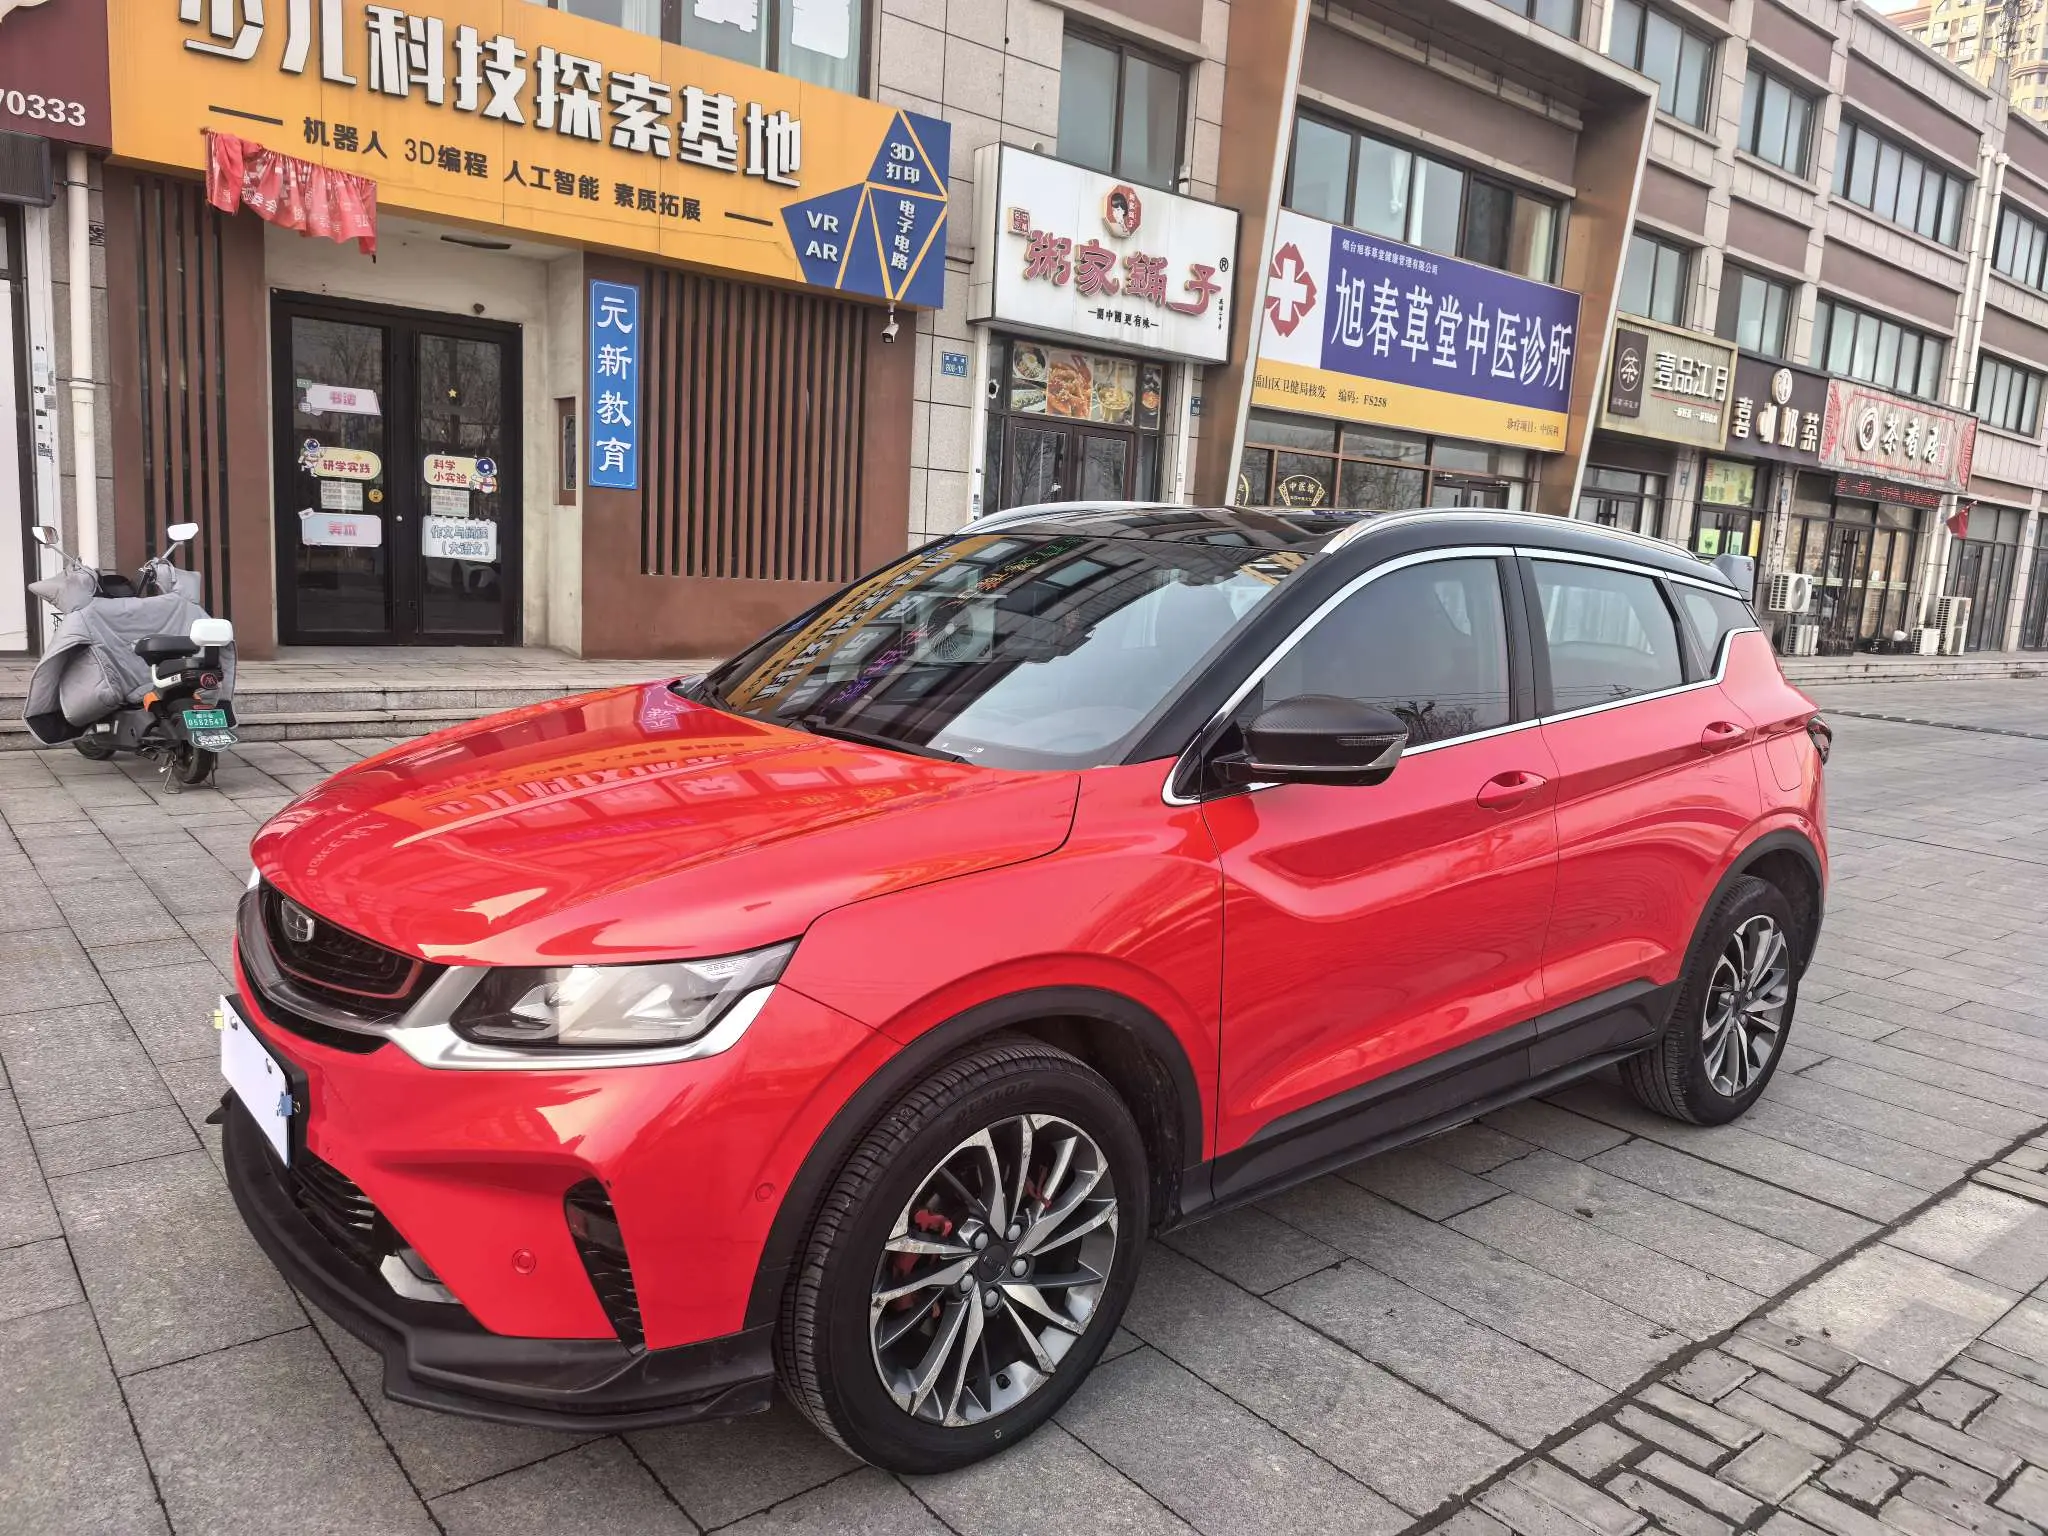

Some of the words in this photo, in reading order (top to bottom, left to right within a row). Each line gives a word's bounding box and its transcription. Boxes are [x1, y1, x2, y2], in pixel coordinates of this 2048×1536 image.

[178, 0, 801, 188] 少儿科技探索基地
[889, 141, 916, 163] 3D
[303, 116, 388, 159] 机器人
[404, 138, 489, 179] 3D编程
[503, 160, 600, 202] 人工智能
[613, 182, 702, 224] 素质拓展
[886, 162, 921, 185] 打印
[806, 209, 839, 234] VR
[890, 199, 916, 271] 电子电路
[805, 240, 839, 263] AR
[1330, 267, 1574, 392] 旭春草堂中医诊所
[1620, 356, 1639, 384] 茶
[595, 295, 634, 474] 元新教育
[1363, 394, 1388, 408] FS258
[322, 458, 372, 475] 研学实践
[433, 459, 456, 471] 科学
[433, 471, 468, 485] 小实验
